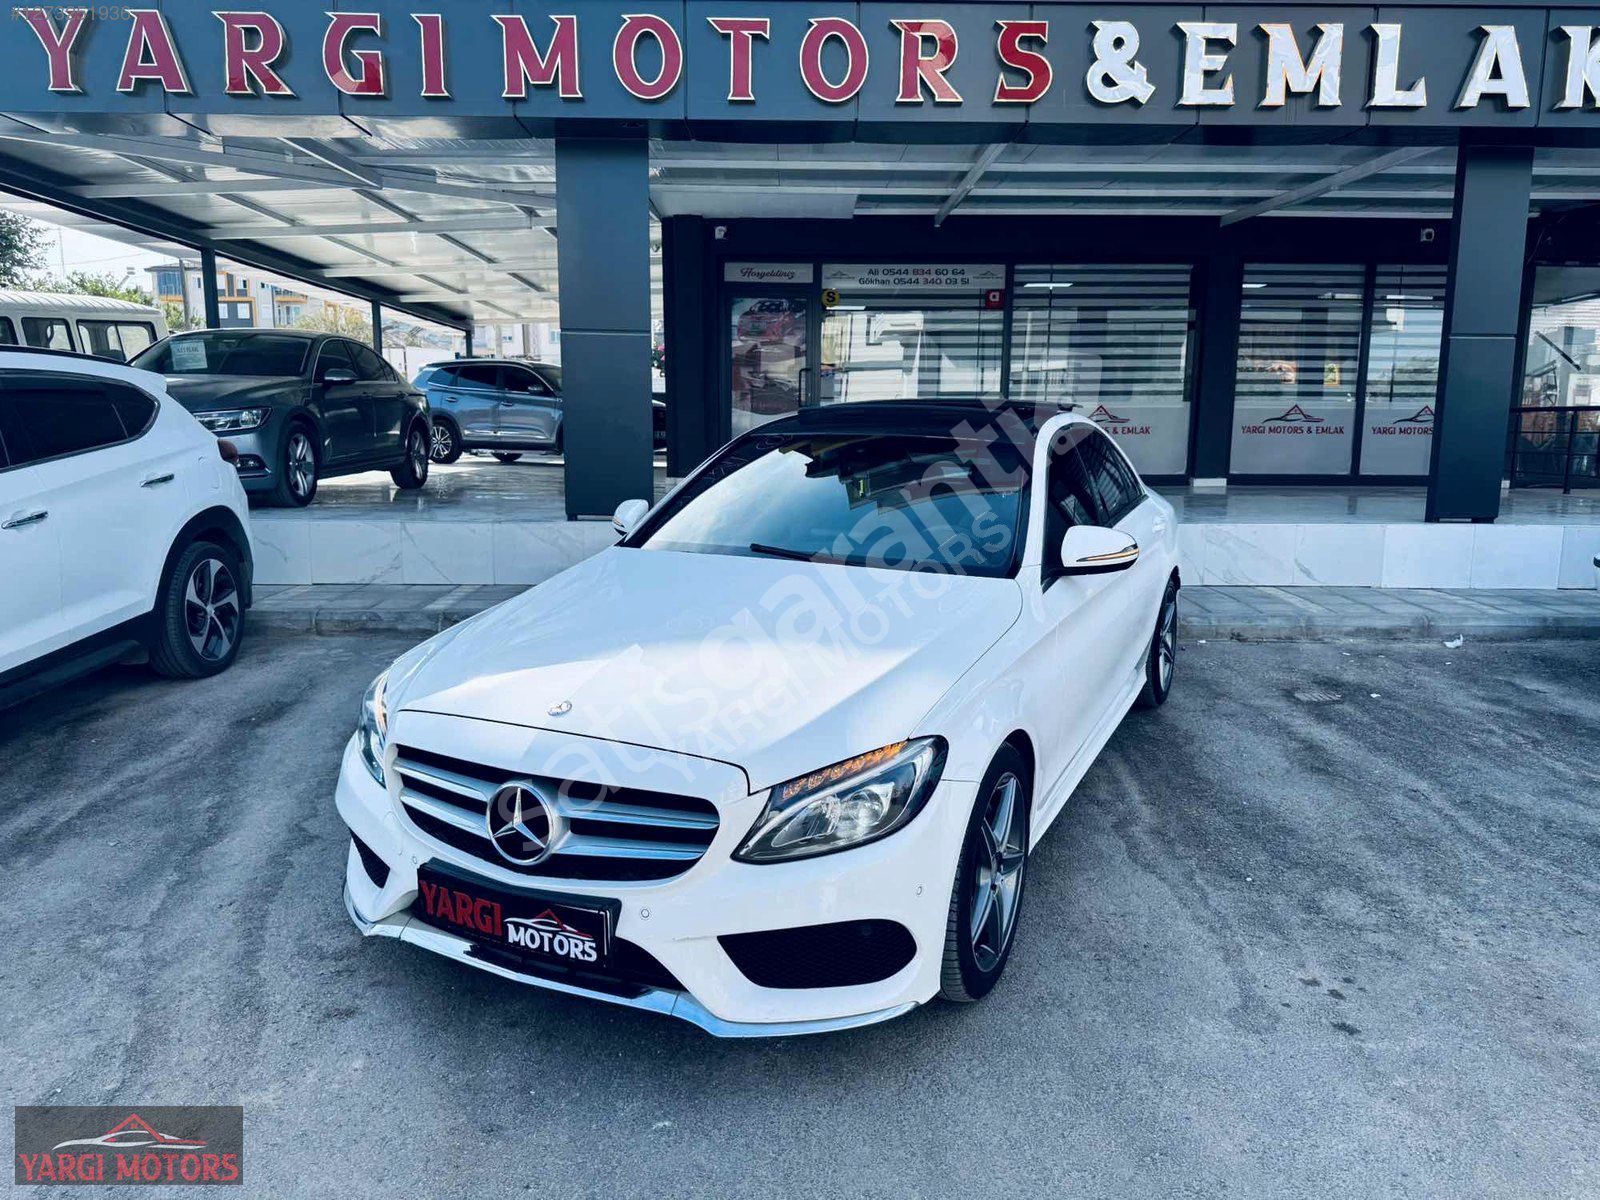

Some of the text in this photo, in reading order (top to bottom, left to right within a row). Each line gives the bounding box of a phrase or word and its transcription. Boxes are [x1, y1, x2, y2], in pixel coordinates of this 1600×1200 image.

[14, 8, 1600, 110] YARGI MOTORS & EMLAK
[868, 268, 879, 276] Ali
[882, 268, 909, 276] 0544
[935, 268, 949, 276] 60
[952, 268, 966, 276] 64
[858, 276, 890, 285] Gökhan
[893, 277, 920, 285] 0544
[945, 277, 958, 285] 03
[825, 291, 836, 303] S
[1121, 426, 1151, 435] EMLAK
[1241, 425, 1345, 435] YARGI MOTORS & EMLAK
[1371, 426, 1434, 435] YARGI MOTORS
[419, 879, 501, 936] YARGI
[507, 924, 598, 963] MOTORS
